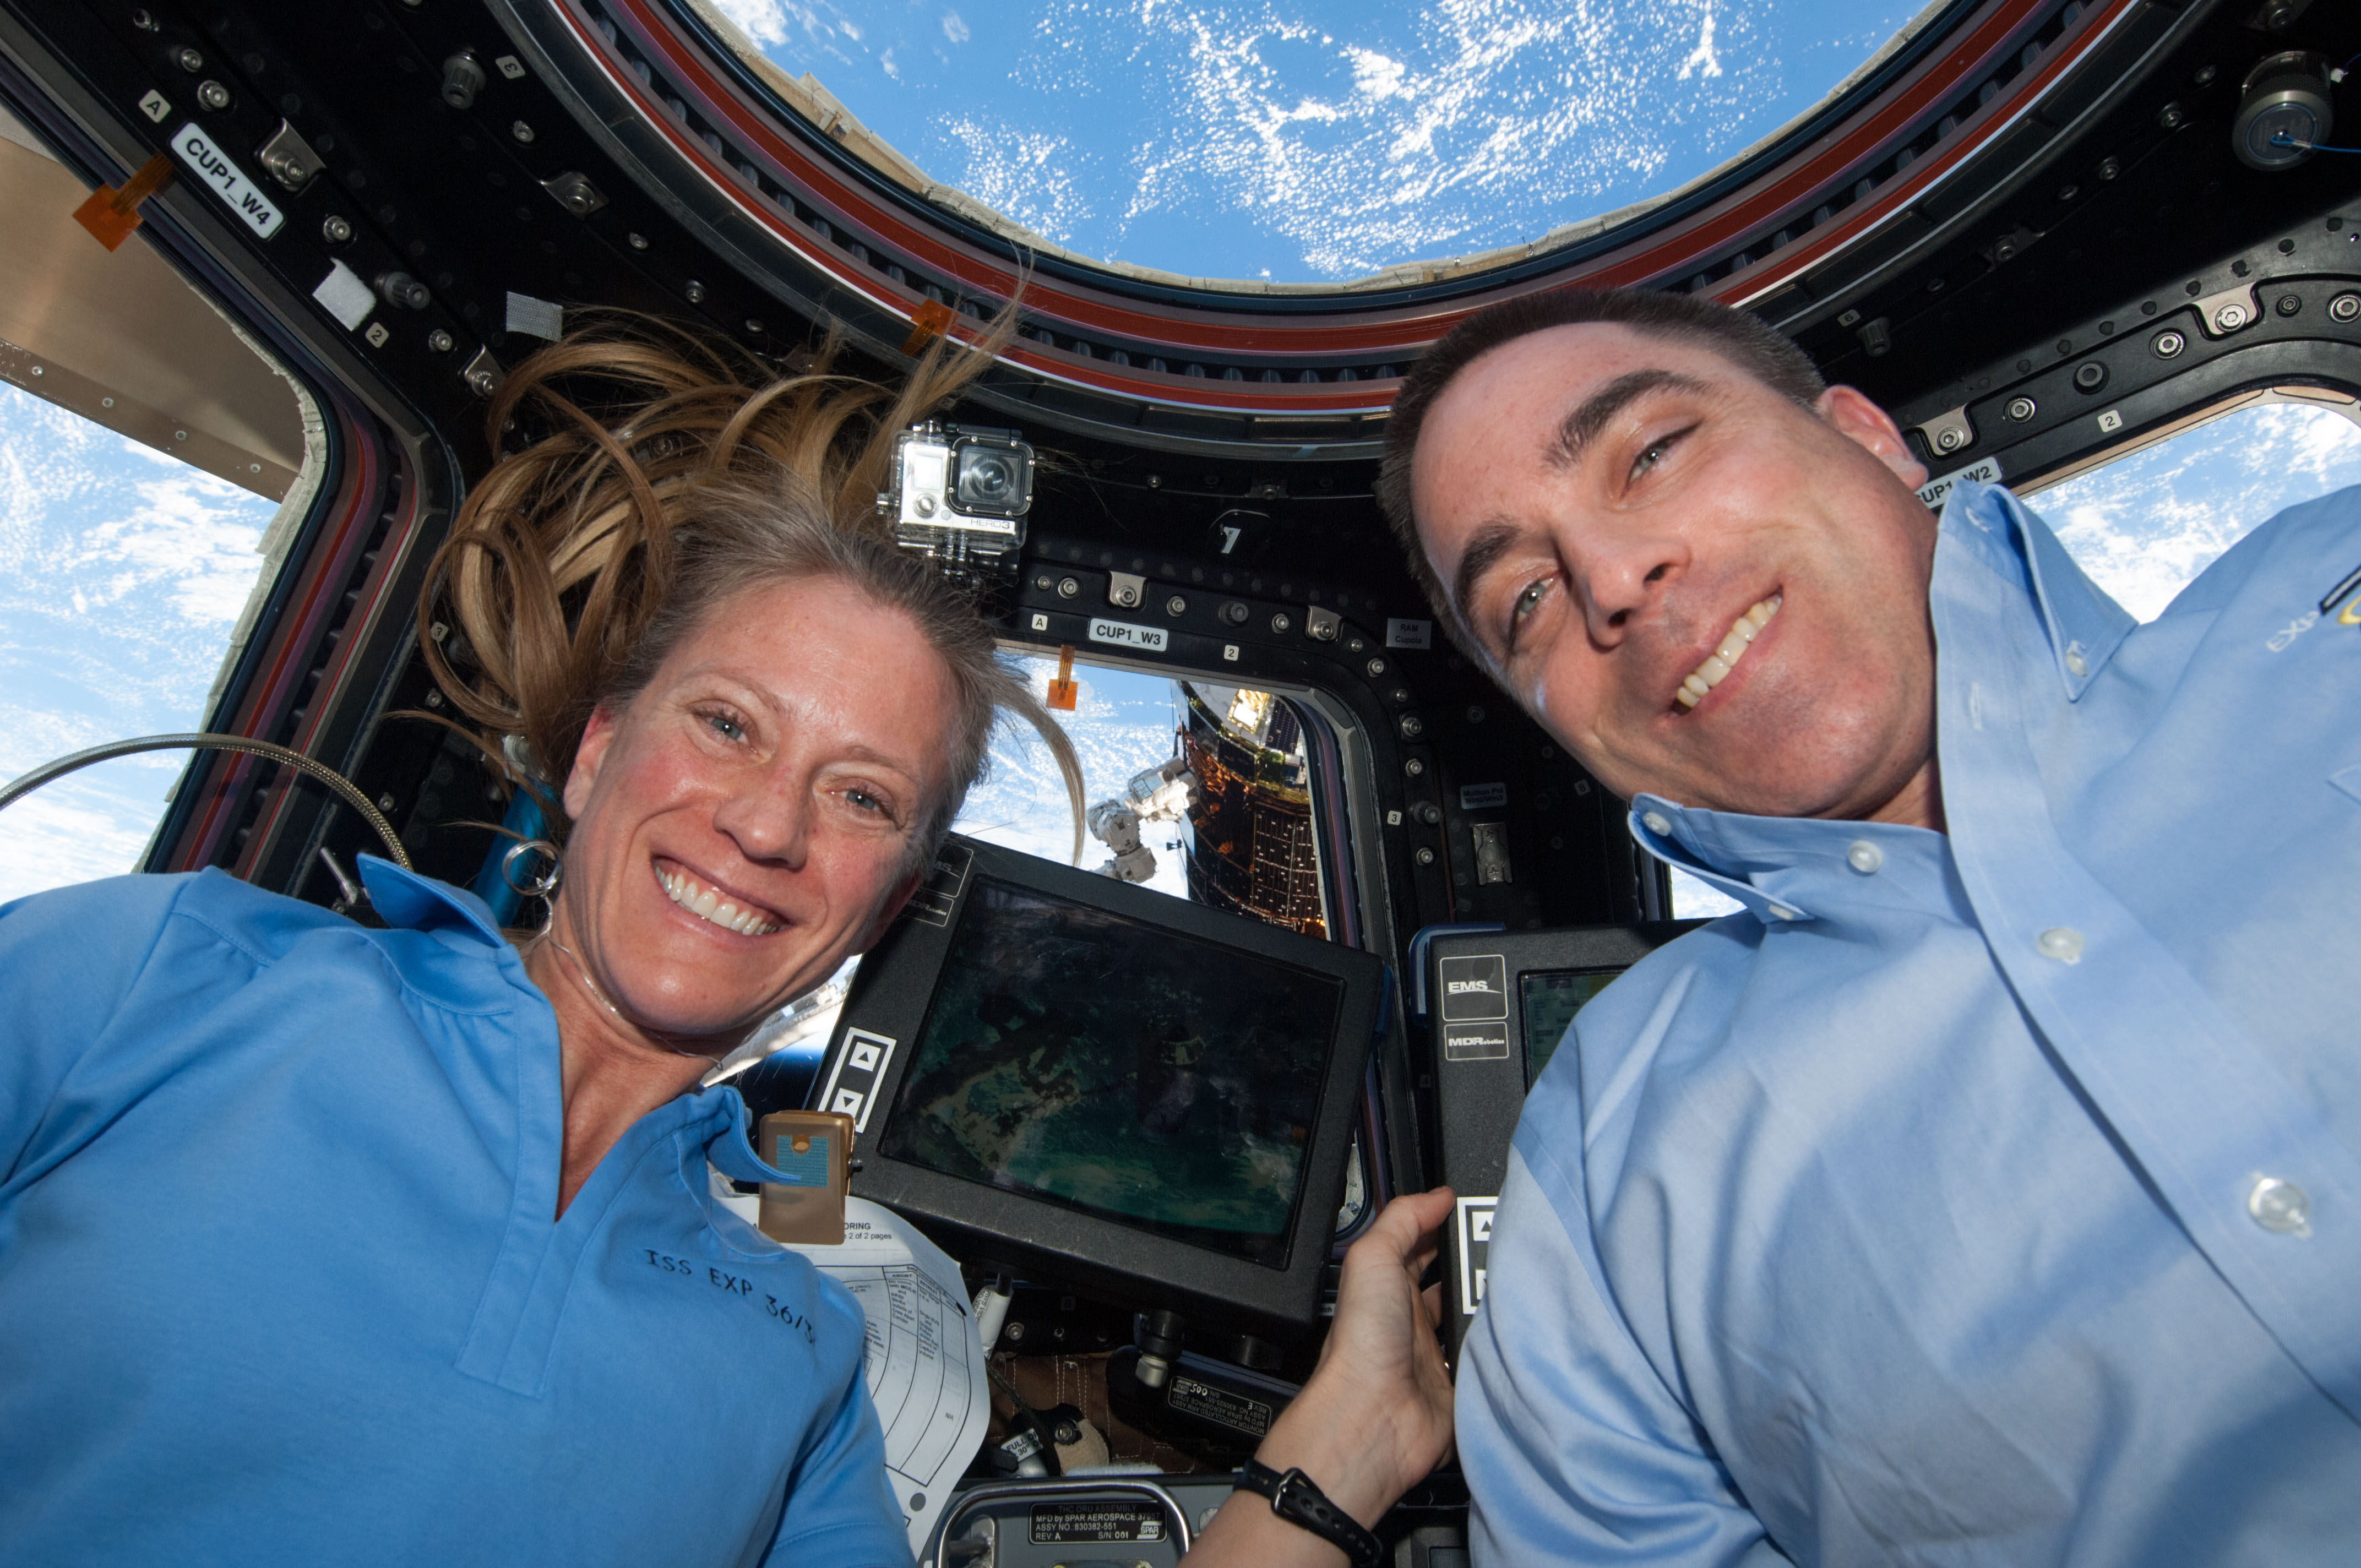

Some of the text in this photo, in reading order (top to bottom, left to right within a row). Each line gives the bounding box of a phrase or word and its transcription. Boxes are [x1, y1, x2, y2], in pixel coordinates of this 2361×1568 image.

[504, 63, 518, 72] 3
[146, 100, 161, 115] A
[186, 138, 271, 226] CUP1_W4
[372, 329, 383, 342] 2
[2104, 415, 2116, 428] 2
[971, 519, 1010, 529] HERO3
[1035, 618, 1043, 628] A
[1400, 624, 1419, 632] RAM
[435, 626, 443, 637] 3
[1096, 624, 1161, 646] CUP1_W3
[1395, 635, 1422, 645] Cupola
[1228, 648, 1235, 658] 2
[1391, 814, 1397, 823] 3
[1448, 980, 1488, 993] EMS
[1448, 1037, 1505, 1047] MDRobotics
[645, 1249, 815, 1346] ISS EXP 36/3
[1187, 1403, 1201, 1414] ARM
[1190, 1398, 1226, 1415] AEROSPACE
[1248, 1402, 1254, 1410] E
[1200, 1408, 1238, 1427] ARTICULATED
[1227, 1411, 1243, 1421] SPAR
[1249, 1411, 1266, 1420] ASSY
[1252, 1418, 1265, 1428] MFD
[1007, 1438, 1027, 1452] FULL
[1058, 1504, 1138, 1514] THC ORU ASSEMBLY
[1054, 1515, 1063, 1523] by
[1087, 1513, 1136, 1521] AEROSPACE
[1036, 1523, 1057, 1532] ASSY
[1140, 1525, 1159, 1534] SPAR
[1036, 1532, 1053, 1541] REV:
[1054, 1532, 1062, 1540] A
[1114, 1531, 1129, 1539] 001
